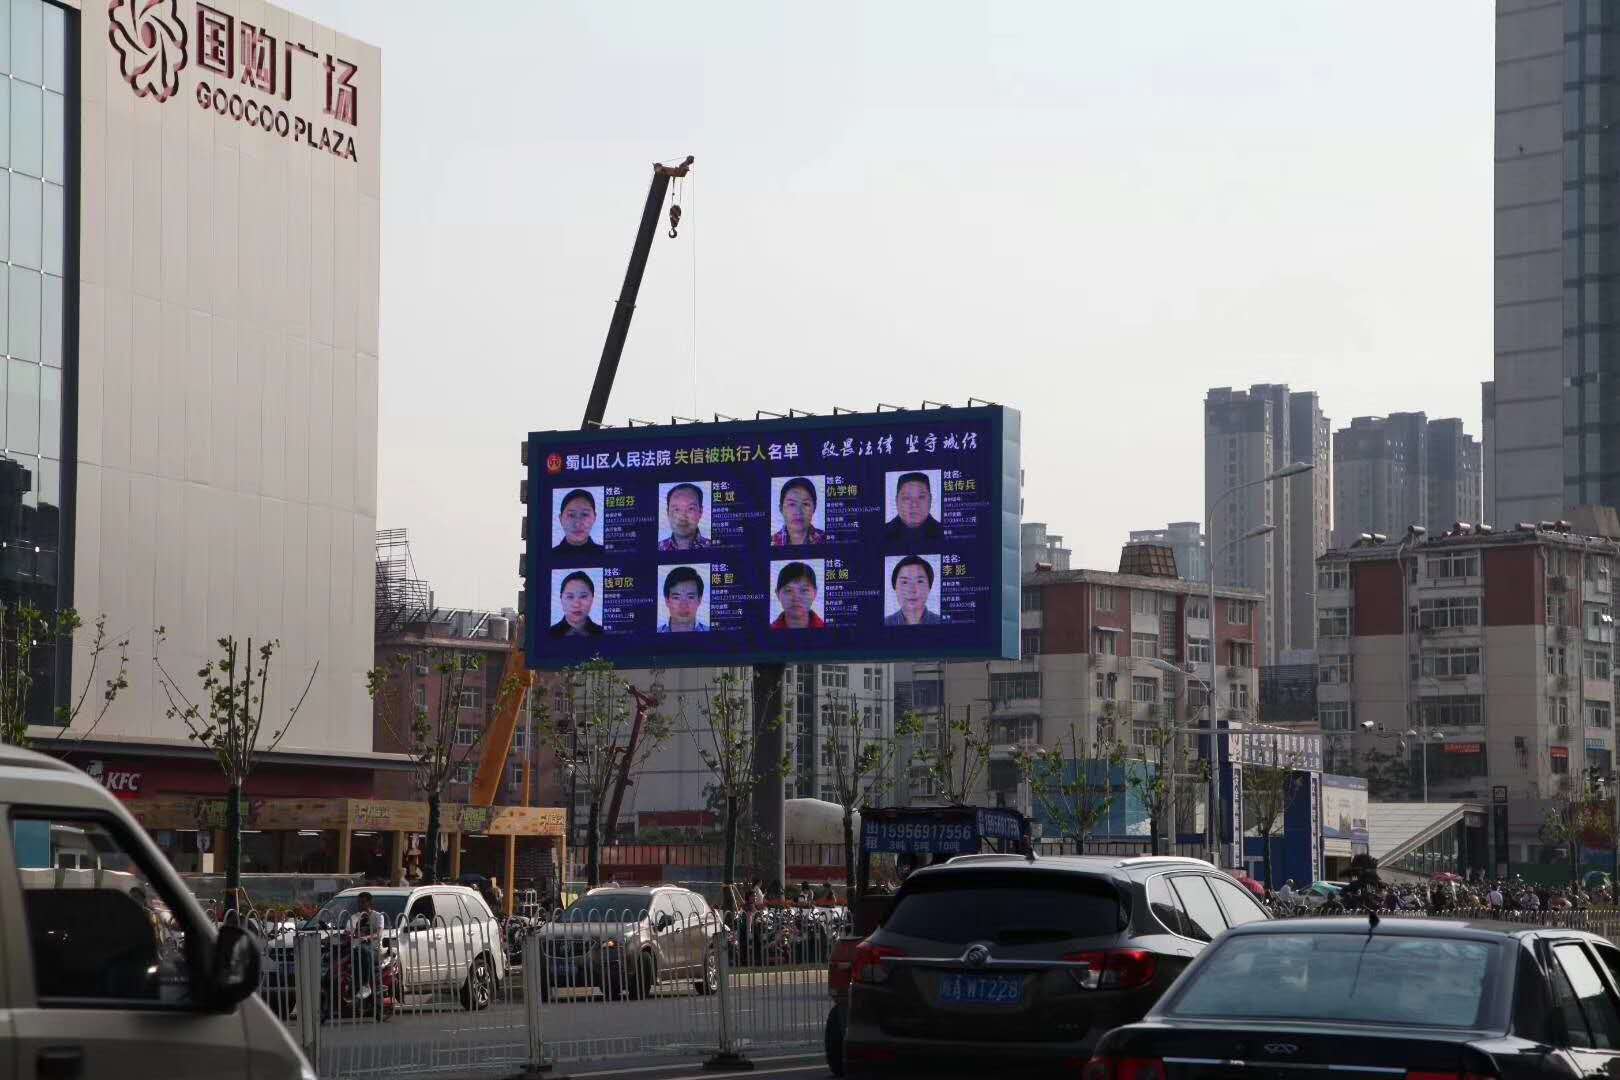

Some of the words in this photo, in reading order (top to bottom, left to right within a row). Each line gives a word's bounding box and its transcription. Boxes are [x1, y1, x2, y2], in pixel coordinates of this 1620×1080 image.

[196, 2, 358, 126] 国购广场
[196, 81, 290, 138] GOOCOO
[295, 116, 358, 163] PLAZA
[565, 450, 672, 470] 蜀山区人民法院
[674, 442, 799, 466] 失信被执行人名单
[821, 433, 893, 459] 敬畏法律
[905, 432, 978, 455] 坚守诚信
[106, 772, 141, 791] KFC
[865, 821, 879, 849] 出租
[880, 824, 971, 840] 15956917556
